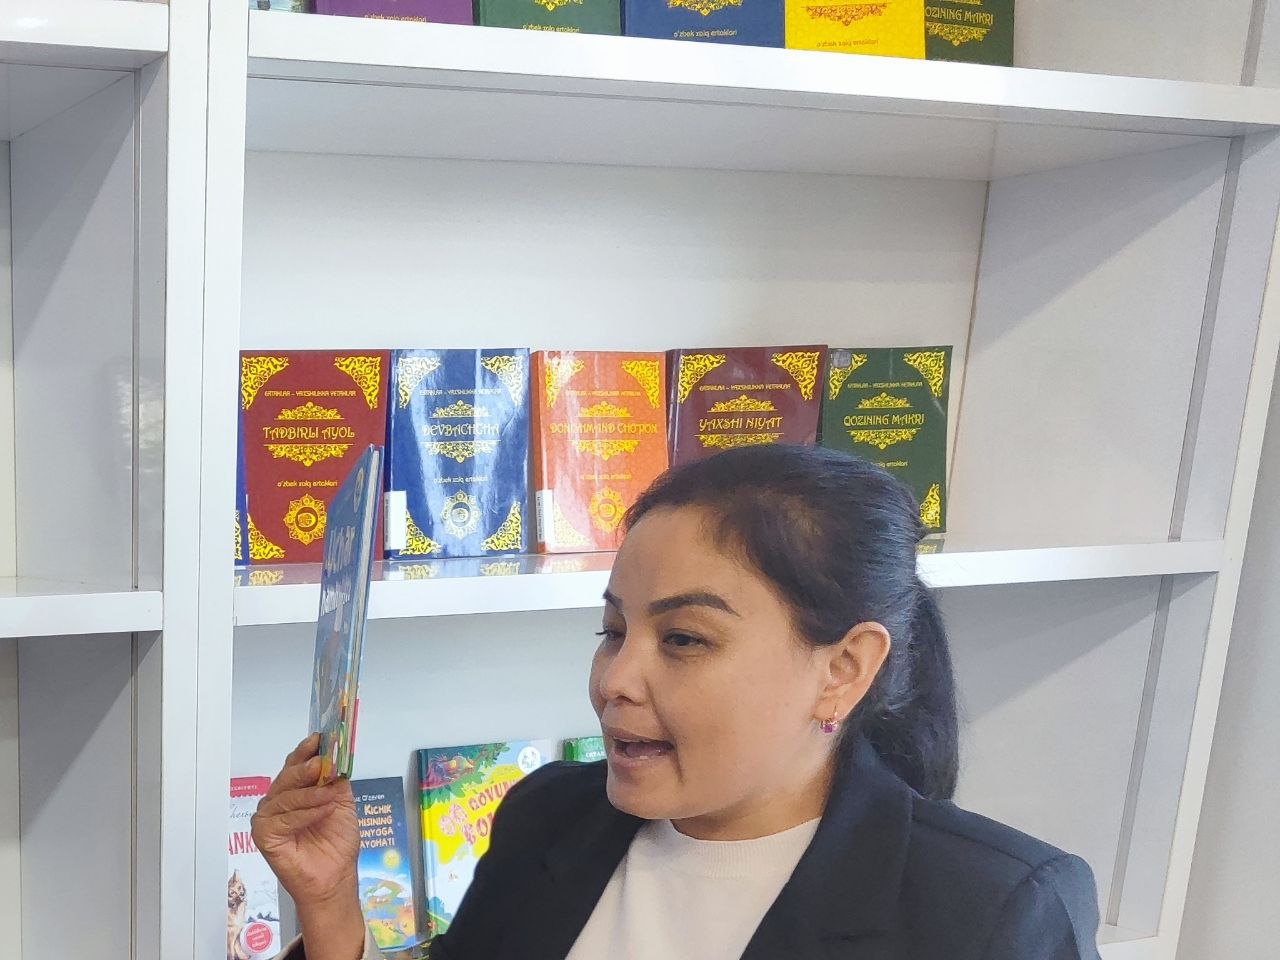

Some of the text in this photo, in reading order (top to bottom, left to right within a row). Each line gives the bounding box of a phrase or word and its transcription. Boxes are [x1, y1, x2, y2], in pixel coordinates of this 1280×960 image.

[925, 6, 994, 26] OZINING MAKRI
[699, 415, 784, 431] YAXSHI NIYAT
[843, 412, 925, 427] QOZINING MAKRI
[262, 426, 356, 440] TADBIRLI AYOL
[422, 423, 501, 438] DEVBACHCHA
[357, 815, 393, 827] HISINING
[359, 827, 394, 838] UNYOGA
[360, 837, 395, 849] AYOHATI
